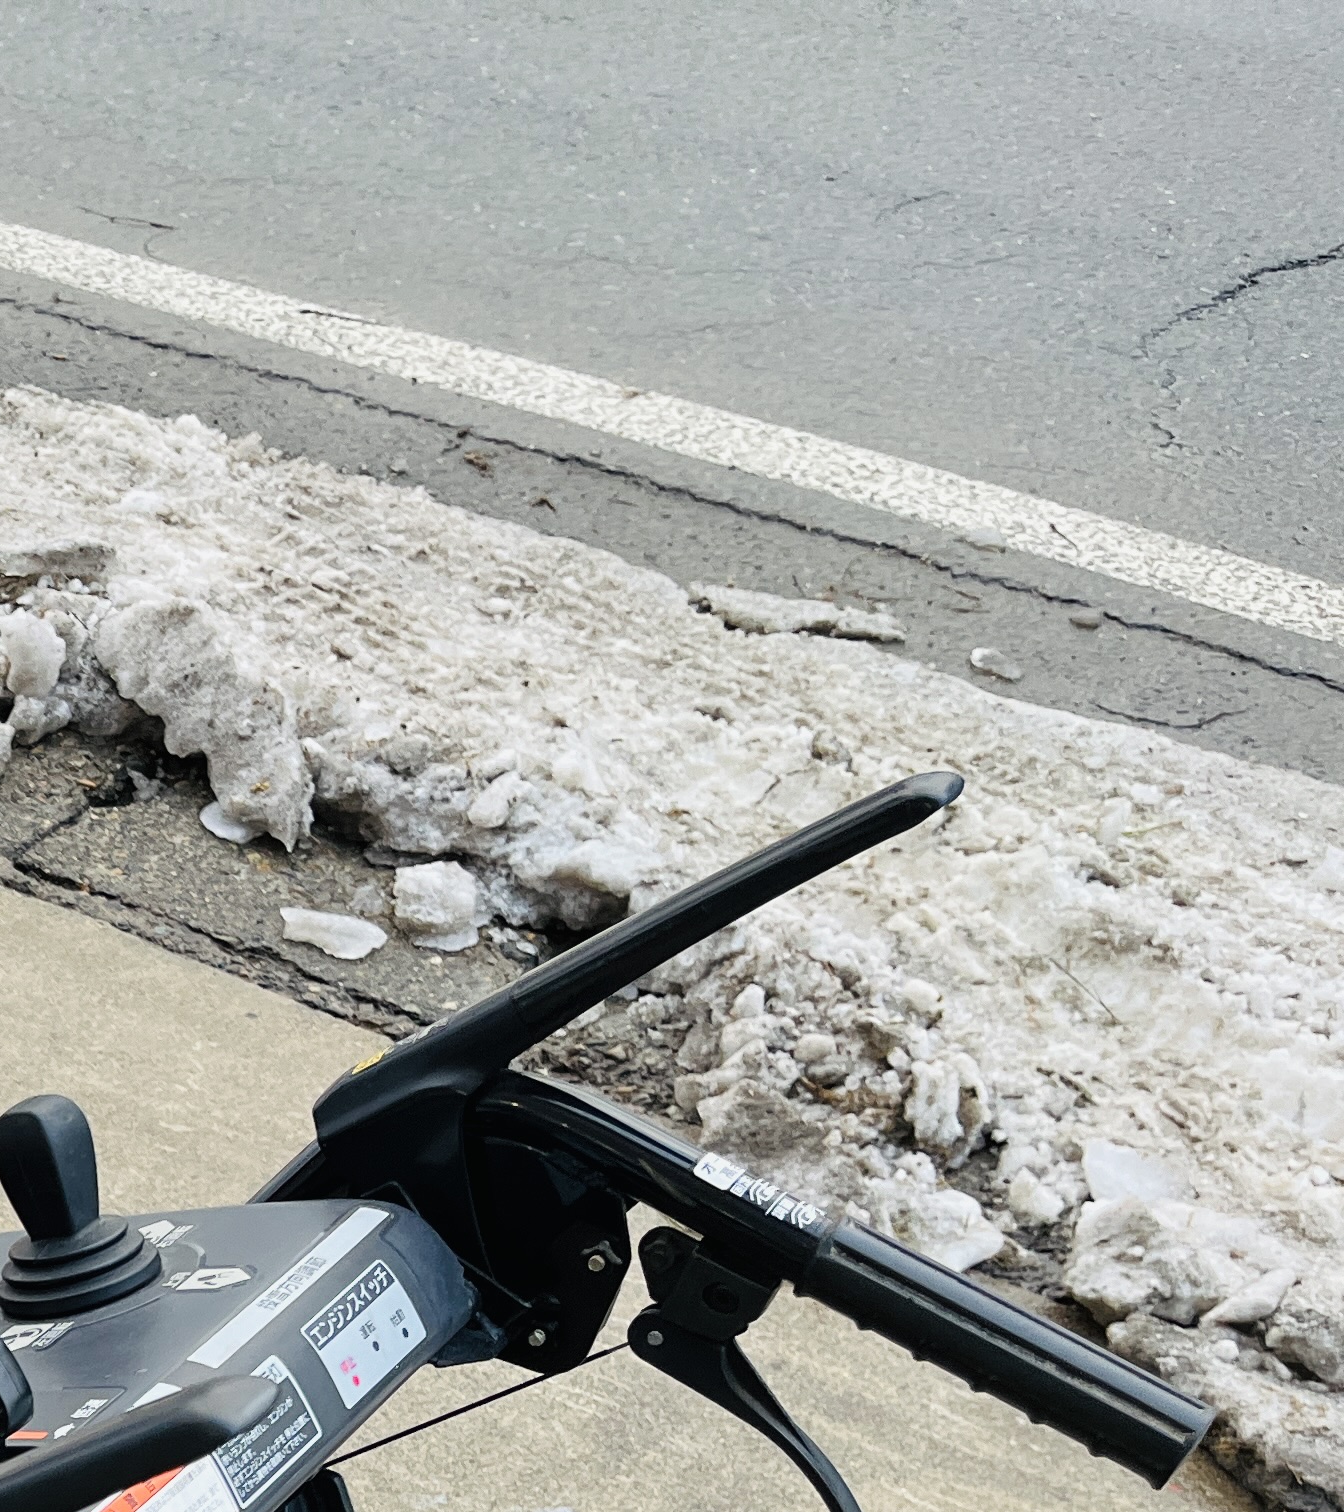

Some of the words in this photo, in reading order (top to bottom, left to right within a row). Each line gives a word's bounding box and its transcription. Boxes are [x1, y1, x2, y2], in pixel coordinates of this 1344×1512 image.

[309, 1266, 388, 1347] エンジンスイッチ
